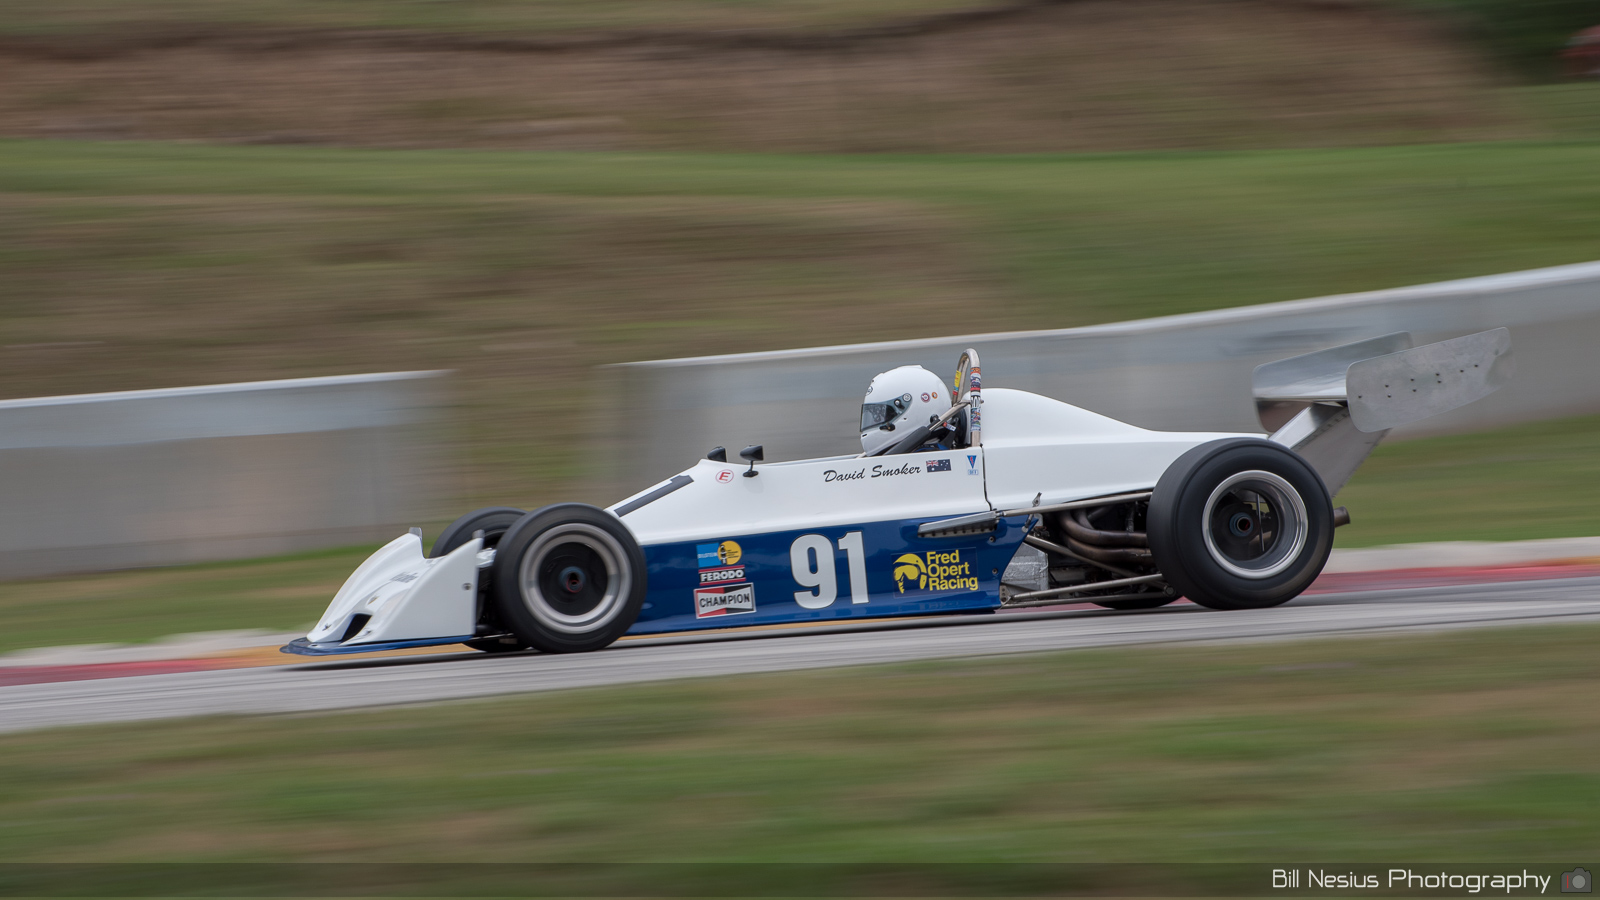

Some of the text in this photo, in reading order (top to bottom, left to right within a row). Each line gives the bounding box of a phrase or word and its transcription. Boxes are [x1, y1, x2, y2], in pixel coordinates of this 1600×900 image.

[719, 472, 731, 482] E
[823, 463, 921, 483] David Smoker
[926, 549, 960, 565] Fred
[700, 569, 744, 582] FERODO
[790, 531, 870, 610] 91
[927, 562, 970, 579] Opert
[928, 576, 979, 591] Racing
[699, 593, 750, 608] CHAMPION
